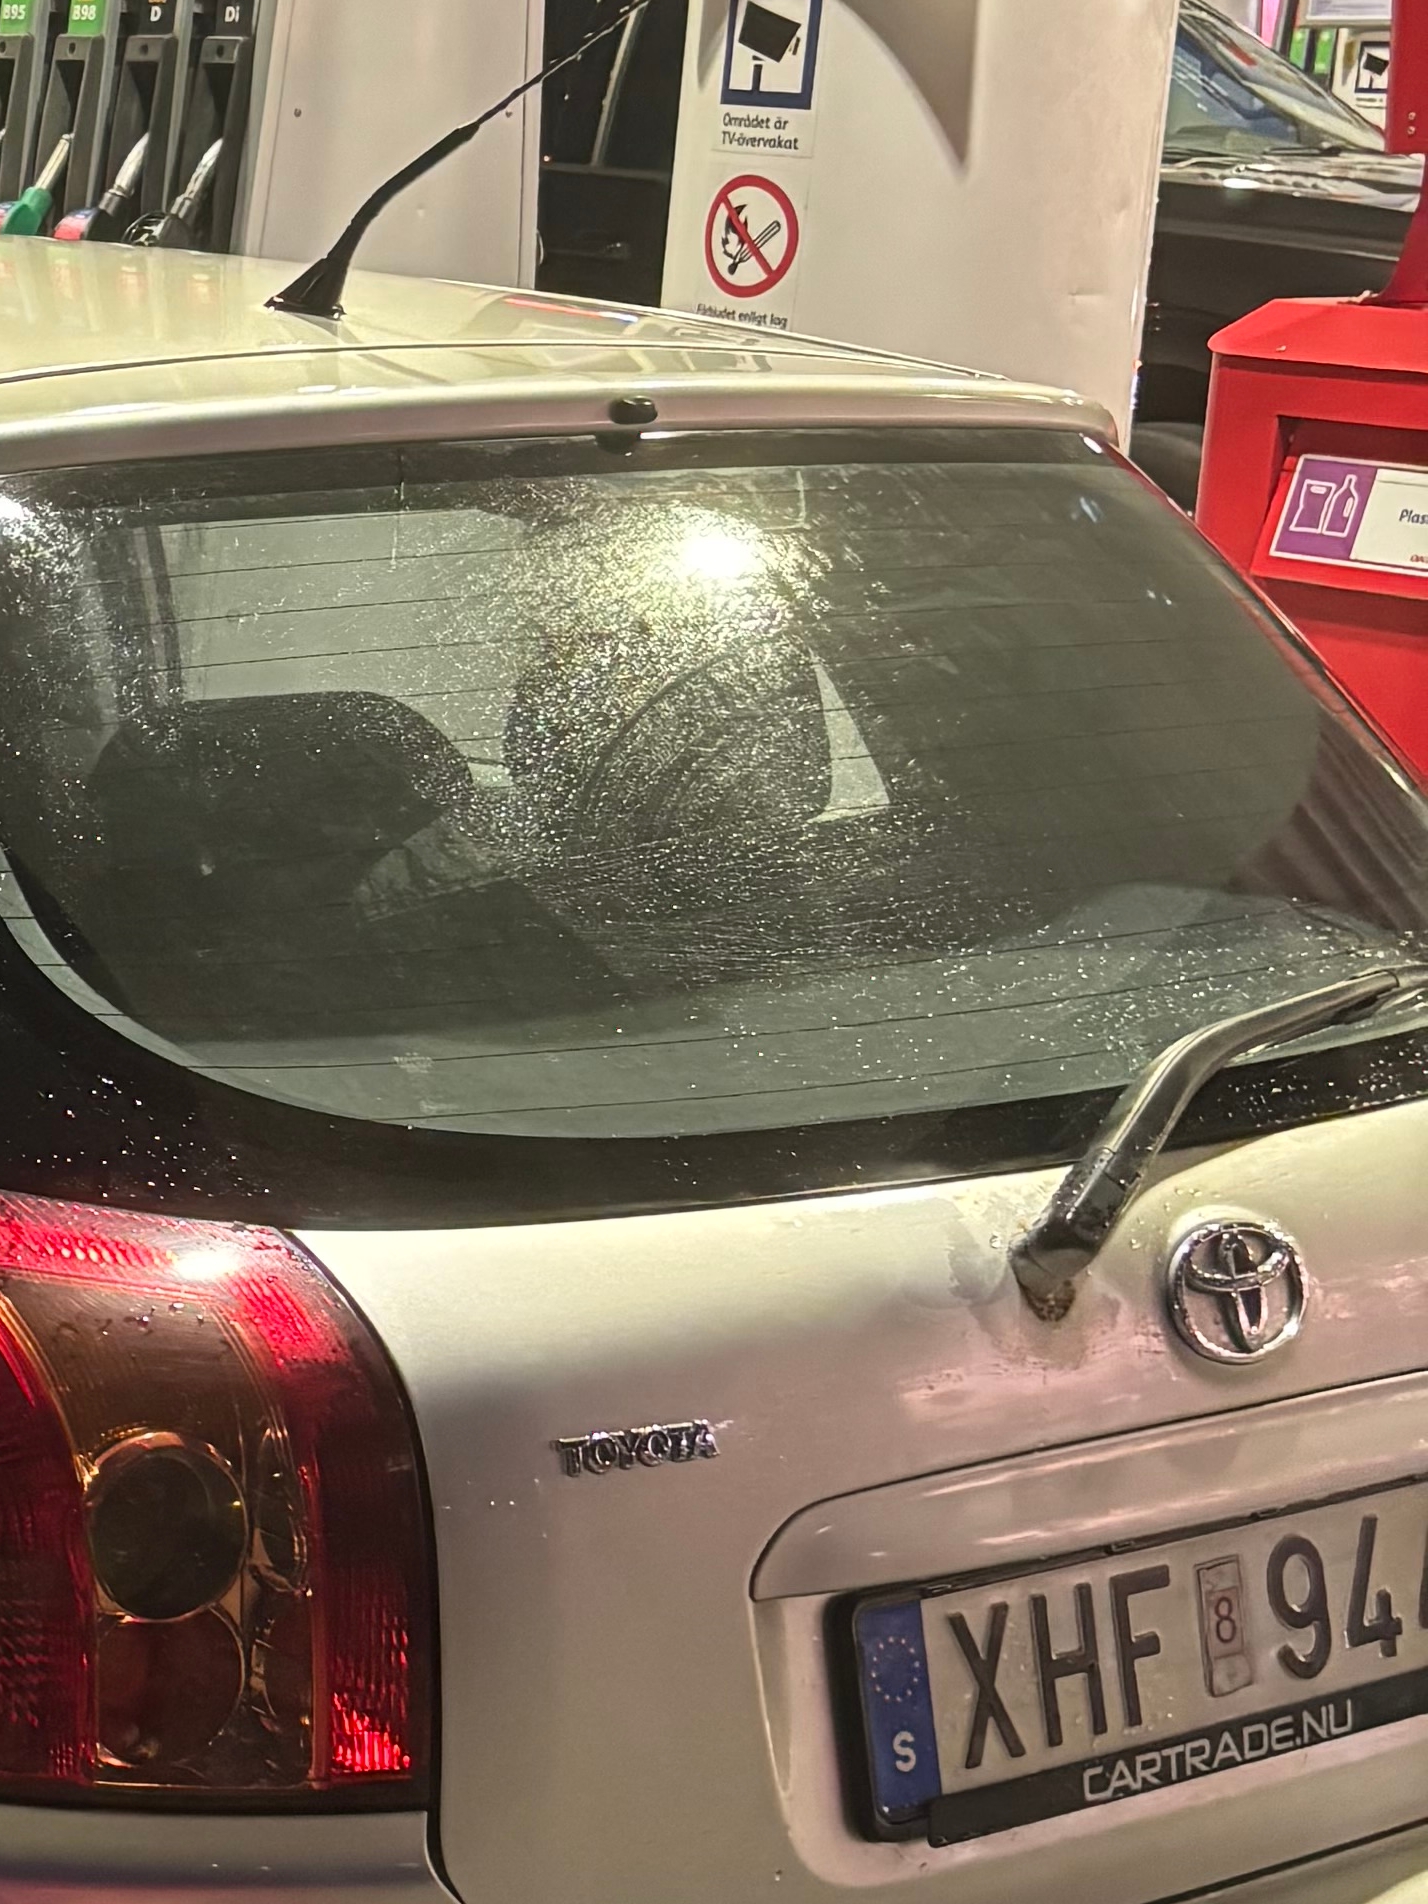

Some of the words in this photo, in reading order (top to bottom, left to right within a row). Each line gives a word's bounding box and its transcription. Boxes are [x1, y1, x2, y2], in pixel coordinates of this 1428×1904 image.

[71, 4, 97, 21] B98
[150, 5, 162, 22] D
[552, 1419, 721, 1478] TOYOTA
[947, 1562, 1172, 1770] XHF
[1214, 1595, 1238, 1644] 8
[1265, 1514, 1428, 1680] 94
[892, 1729, 919, 1774] S
[1083, 1698, 1354, 1802] CARTRADE.NU
